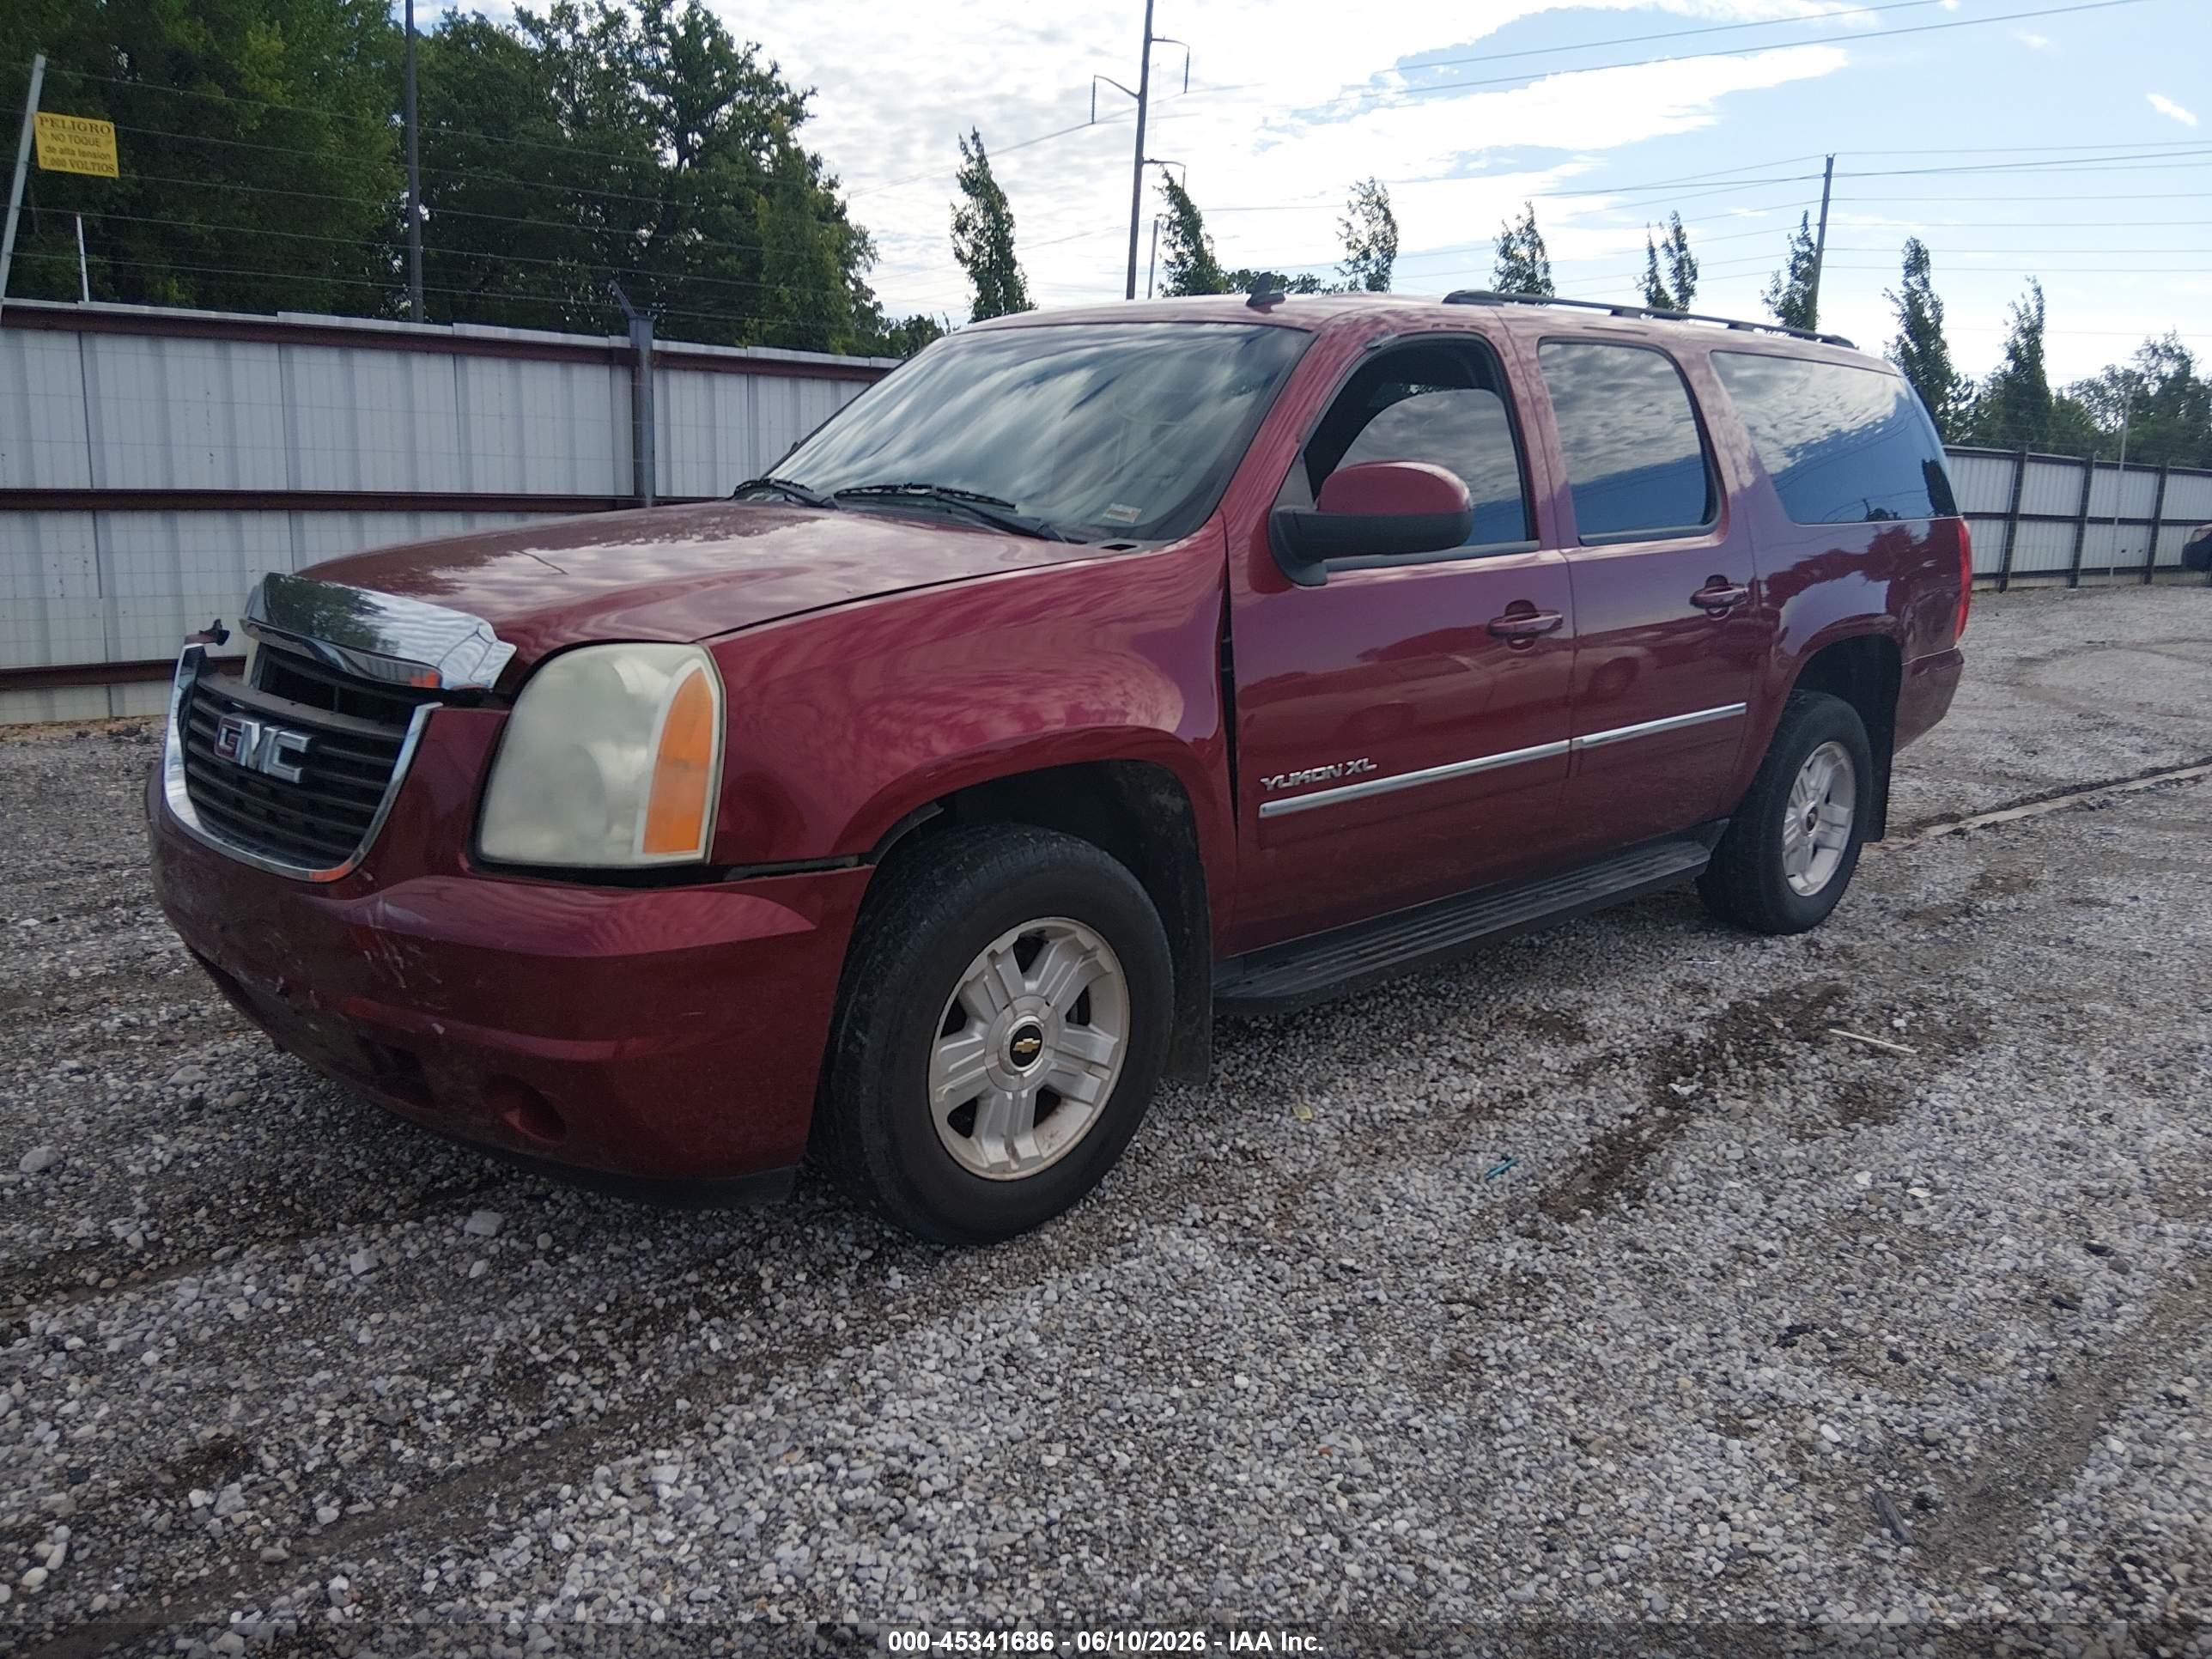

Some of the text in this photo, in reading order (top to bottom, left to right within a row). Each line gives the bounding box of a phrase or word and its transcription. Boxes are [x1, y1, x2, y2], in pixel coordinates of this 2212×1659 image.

[39, 116, 111, 134] PELIGRO
[52, 133, 102, 148] NO TOQUE
[69, 159, 116, 173] VOLTIOS
[214, 714, 311, 784] GMC
[1260, 757, 1377, 791] YUKON XL
